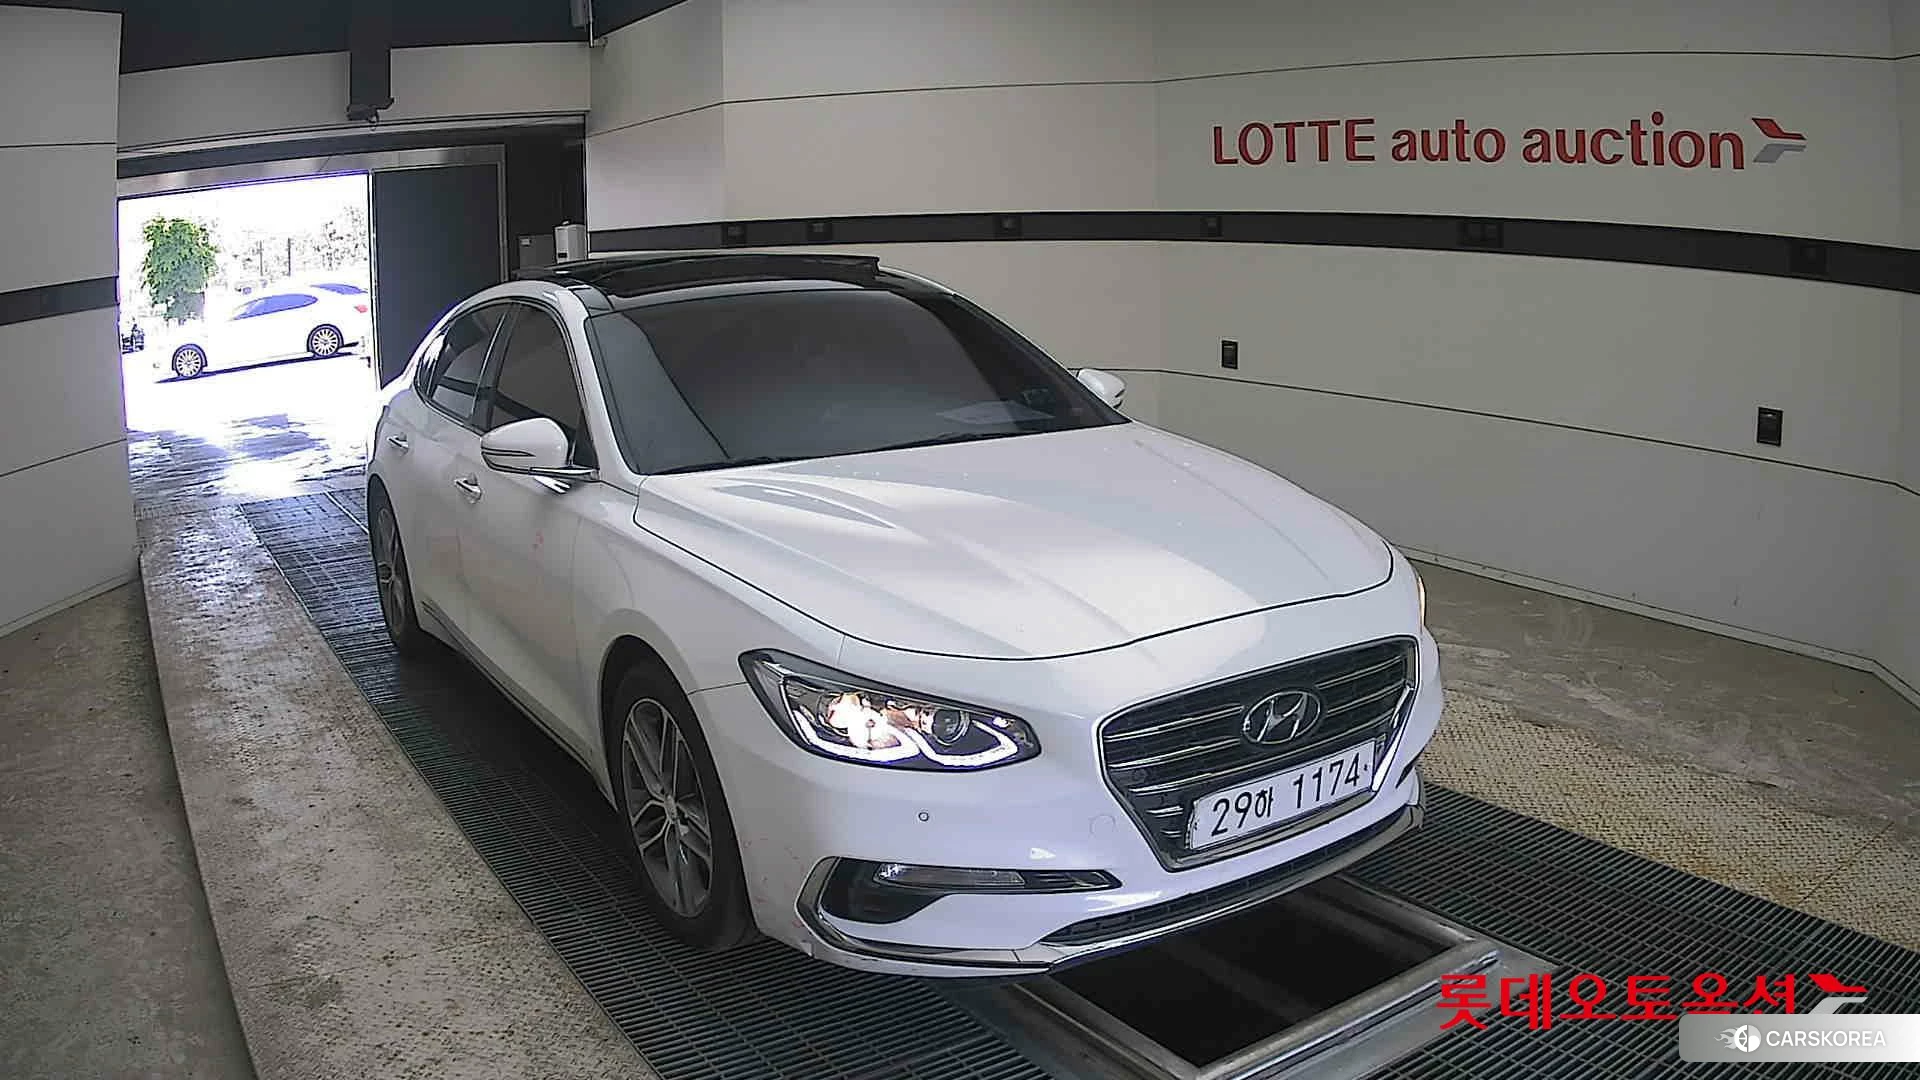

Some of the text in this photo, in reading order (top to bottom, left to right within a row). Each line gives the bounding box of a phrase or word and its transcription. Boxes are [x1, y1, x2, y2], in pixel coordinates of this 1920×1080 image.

[1213, 111, 1745, 170] LOTTE auto auction
[1211, 752, 1361, 837] 29하 1174
